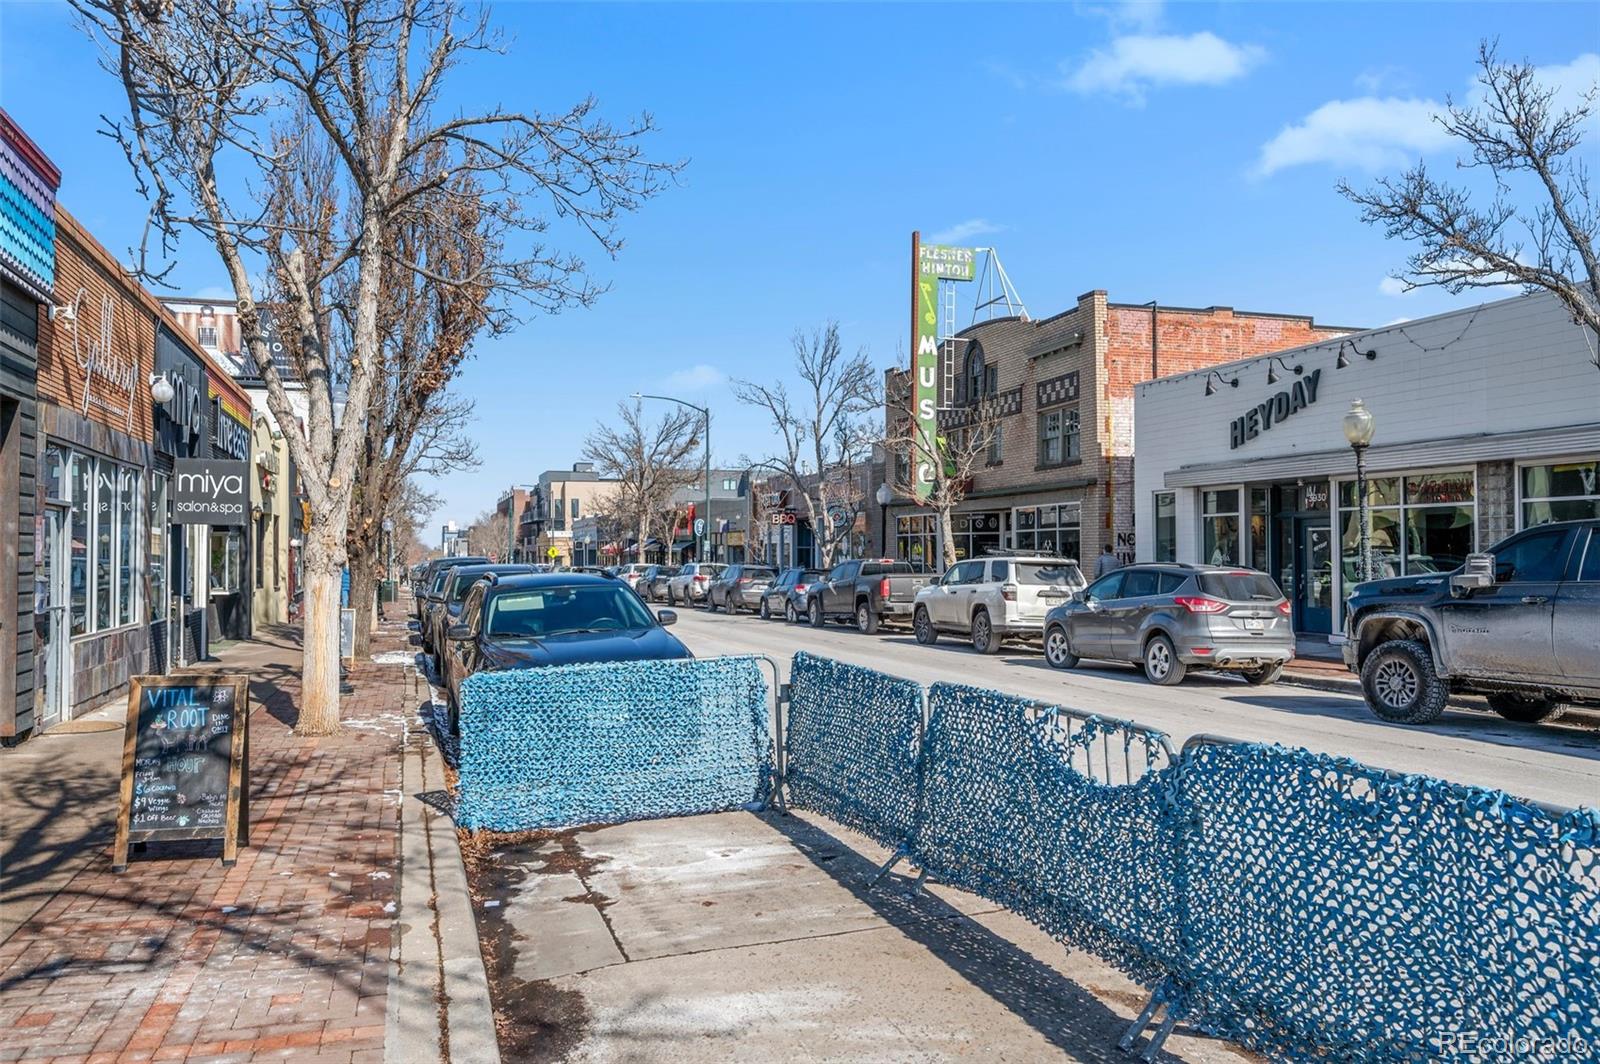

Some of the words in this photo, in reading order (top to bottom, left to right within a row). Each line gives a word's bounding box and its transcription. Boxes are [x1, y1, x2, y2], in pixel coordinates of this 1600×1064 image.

[922, 261, 969, 277] HINTON
[1230, 368, 1321, 450] HEYDAY
[178, 469, 243, 499] miya
[177, 502, 243, 515] salon&spa
[772, 513, 796, 524] BBQ
[147, 688, 200, 708] VITAL
[167, 707, 210, 730] ROOT
